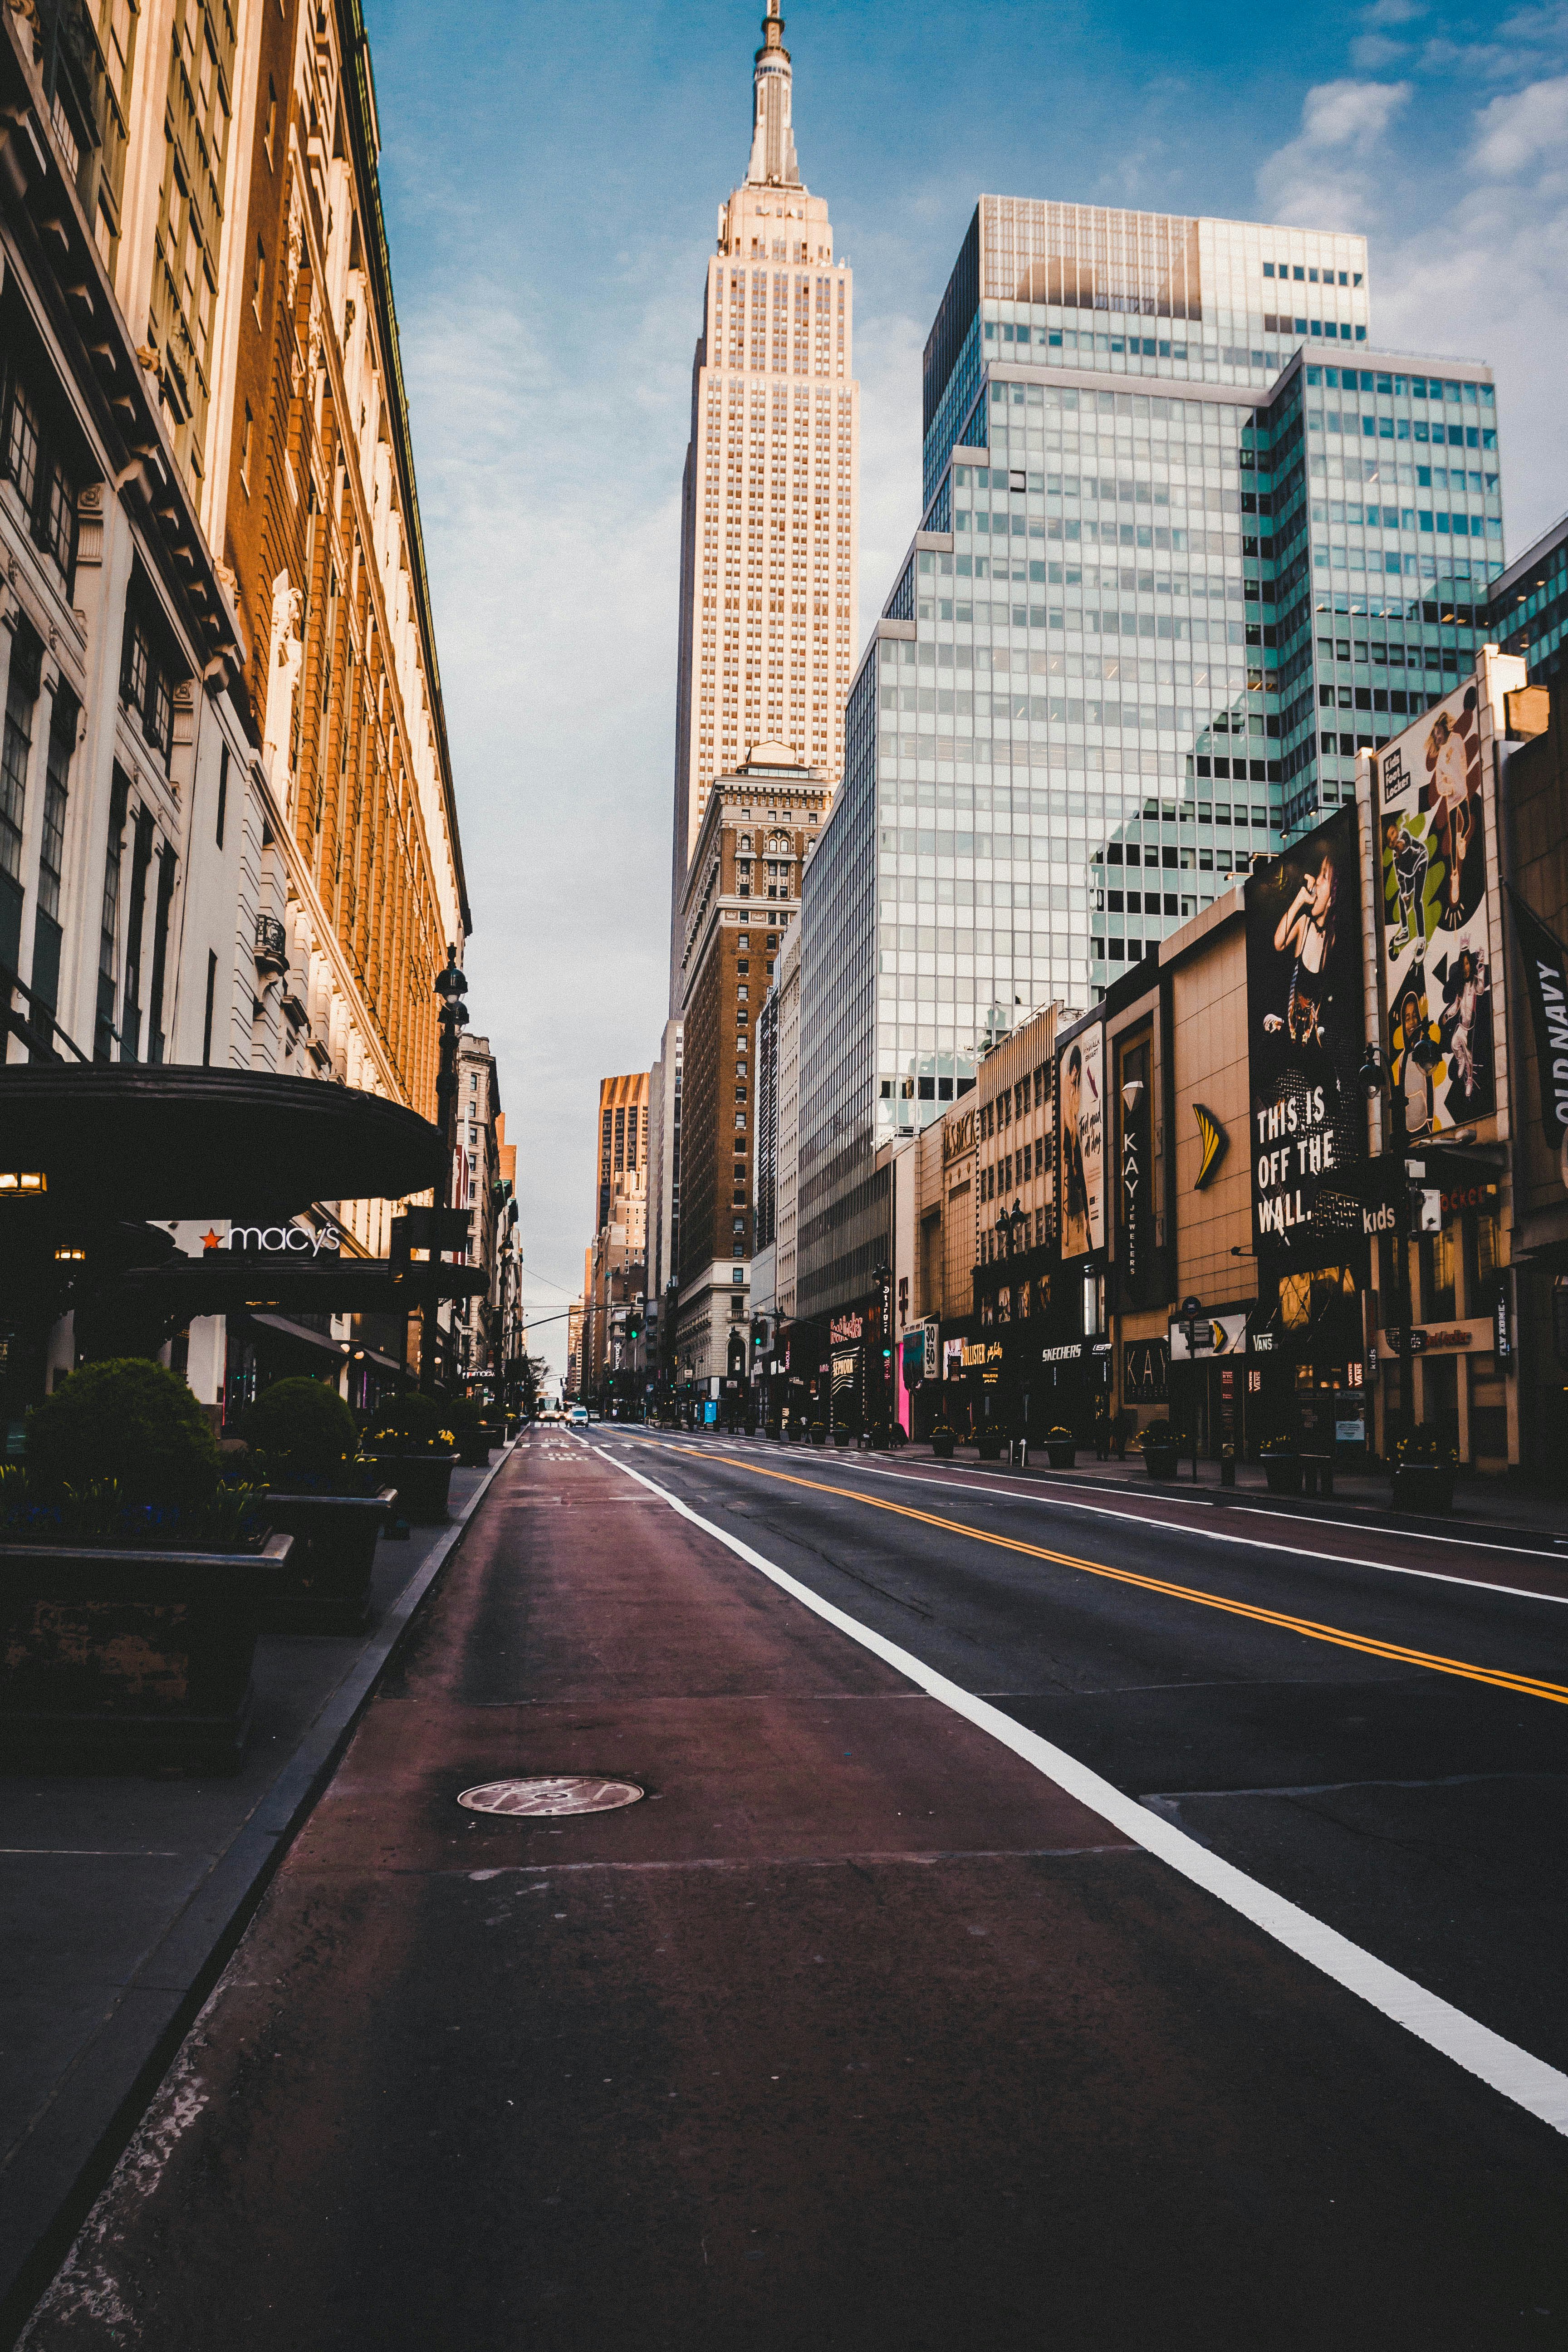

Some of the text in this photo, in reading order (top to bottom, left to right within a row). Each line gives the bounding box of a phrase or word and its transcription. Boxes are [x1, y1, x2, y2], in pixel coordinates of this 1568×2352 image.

[1385, 754, 1400, 773] Kids
[1386, 767, 1401, 787] Foot
[1387, 775, 1409, 800] Locker
[1537, 960, 1568, 1049] NAVY
[1257, 1086, 1324, 1143] THIS IS
[1124, 1133, 1138, 1198] KAY
[1258, 1130, 1334, 1189] OFF THE
[1258, 1190, 1311, 1234] WALL.
[1363, 1185, 1484, 1234] kids ocker
[228, 1222, 340, 1257] macy's
[1498, 1304, 1506, 1335] ZONE
[926, 1326, 935, 1343] 30
[1253, 1333, 1273, 1352] VANS
[612, 1342, 622, 1371] wework
[926, 1348, 935, 1365] 50
[961, 1343, 985, 1366] HOLLISTER
[1043, 1344, 1082, 1362] SKECHERS
[1127, 1348, 1166, 1385] KAY
[833, 1358, 853, 1376] SEPHORA
[1354, 1363, 1362, 1386] VANS
